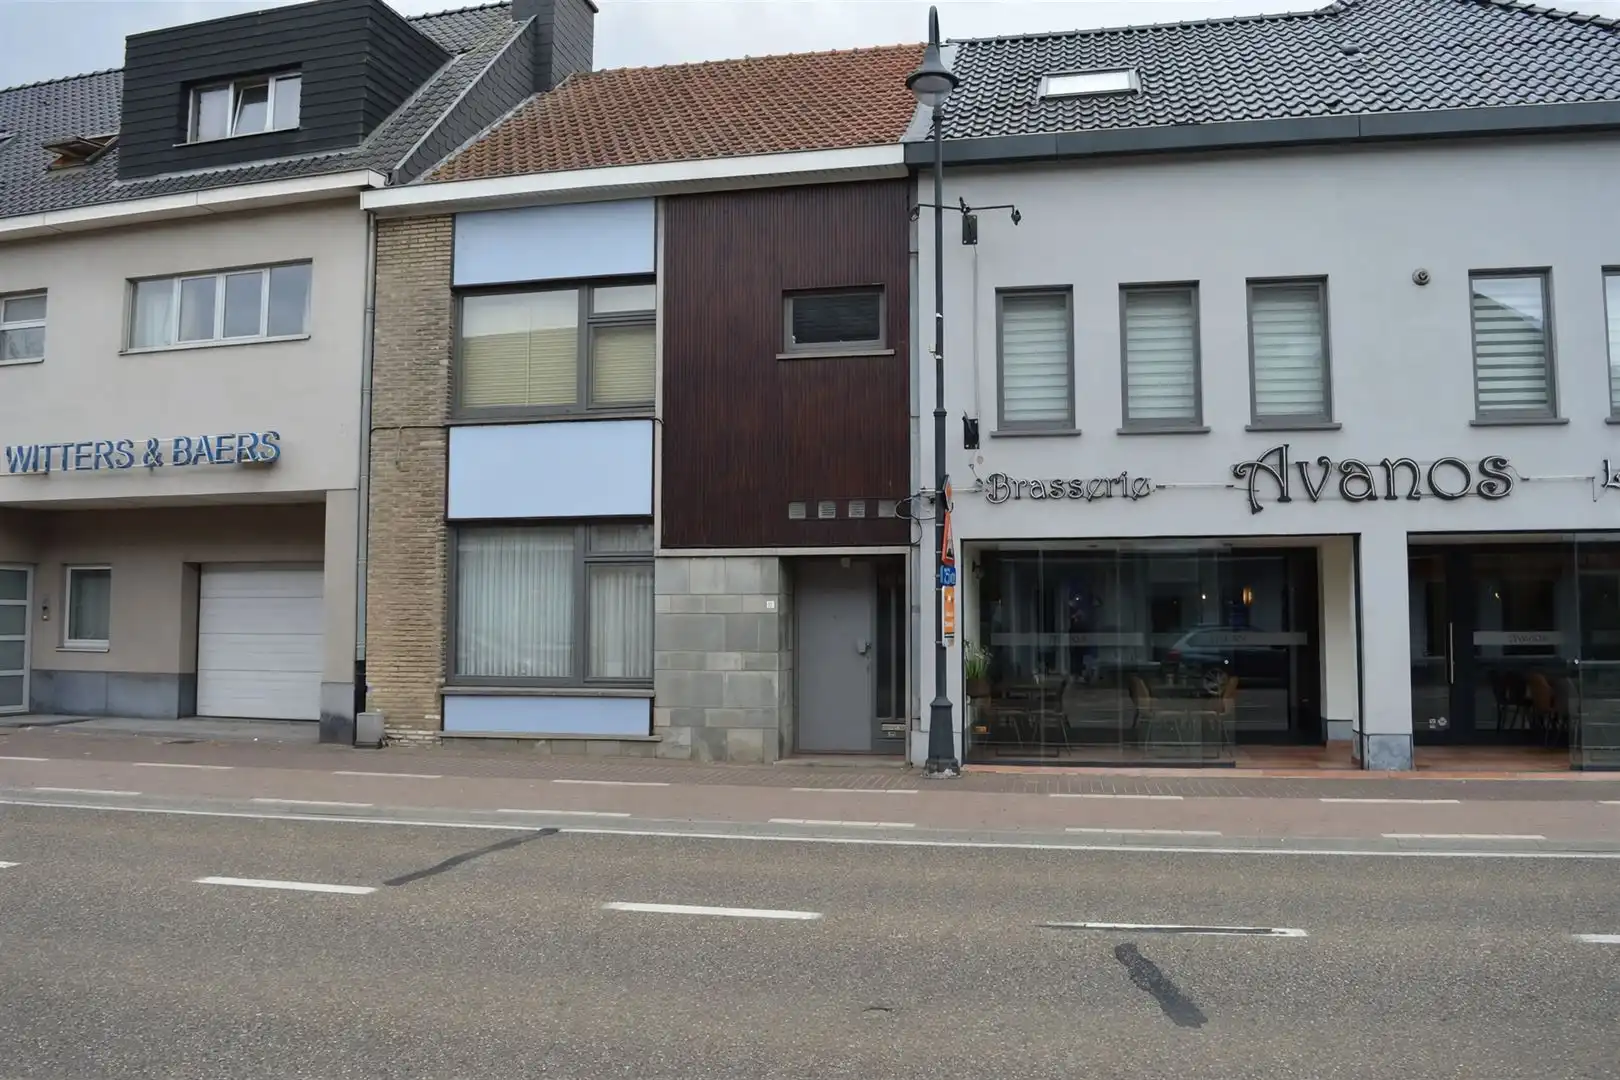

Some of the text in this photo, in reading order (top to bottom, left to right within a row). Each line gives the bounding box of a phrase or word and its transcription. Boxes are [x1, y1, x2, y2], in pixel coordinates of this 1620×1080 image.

[5, 430, 281, 473] WITTERS & BAERS
[986, 470, 1152, 504] Brasserie
[1233, 443, 1514, 515] Avanos
